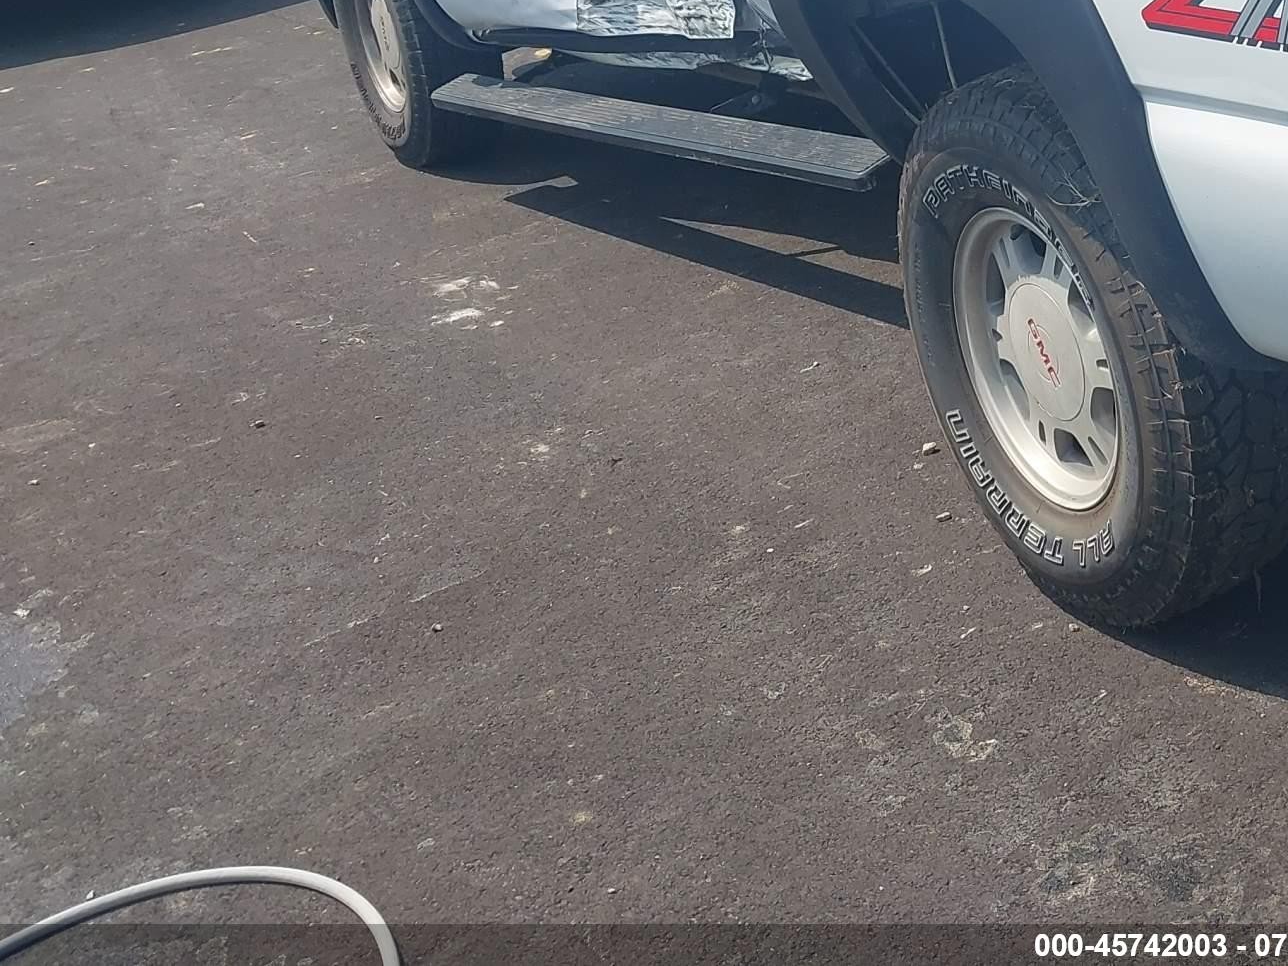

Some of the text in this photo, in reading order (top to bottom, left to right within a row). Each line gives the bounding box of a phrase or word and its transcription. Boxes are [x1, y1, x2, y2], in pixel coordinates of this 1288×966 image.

[1026, 317, 1062, 389] GMC
[945, 408, 1116, 568] ALL TERRAIN
